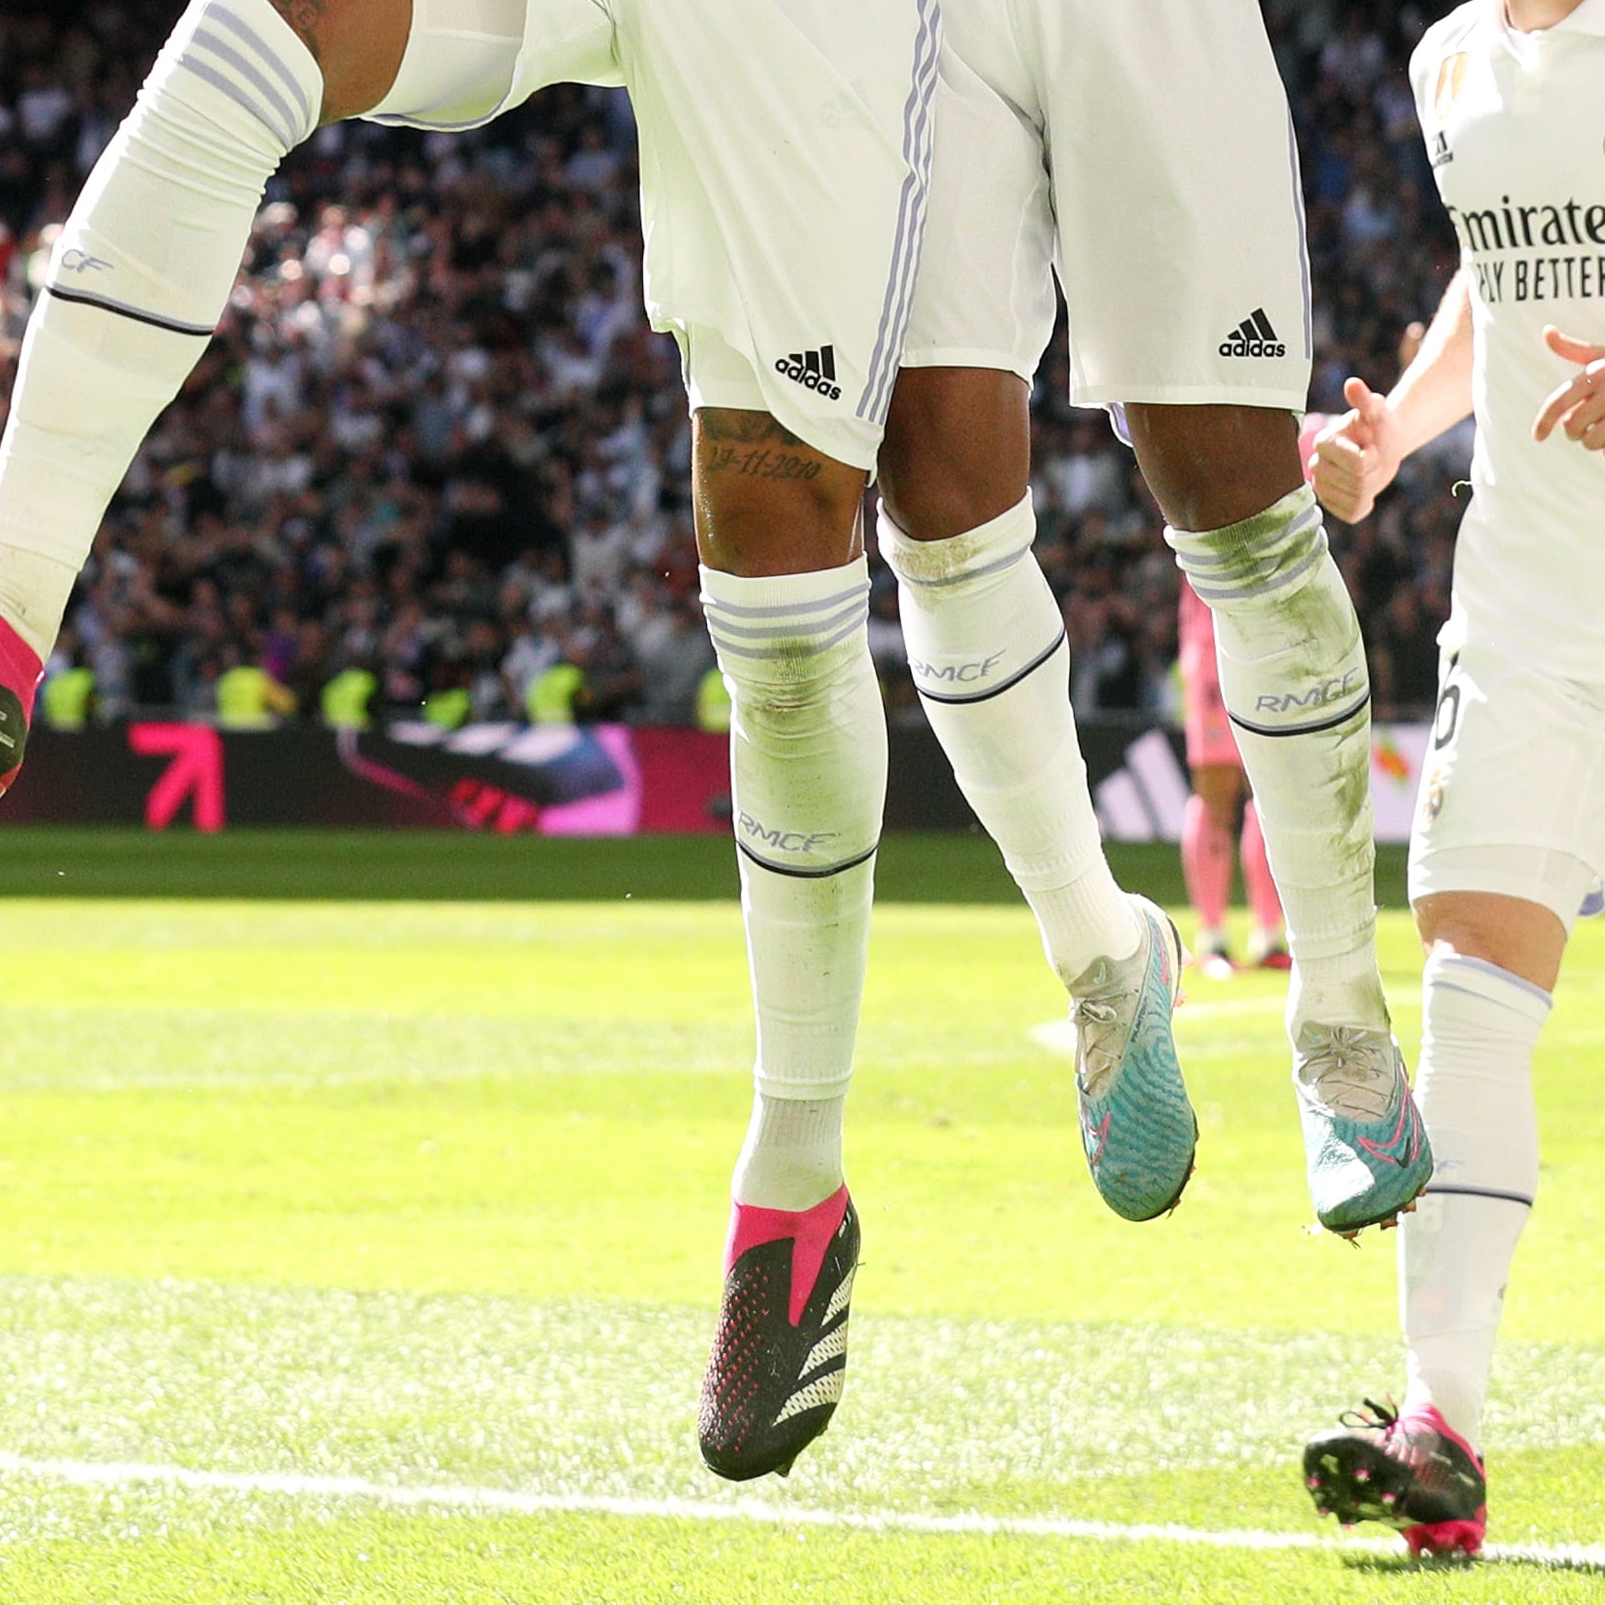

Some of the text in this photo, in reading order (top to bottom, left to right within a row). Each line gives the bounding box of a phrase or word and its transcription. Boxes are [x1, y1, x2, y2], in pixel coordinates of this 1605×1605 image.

[61, 249, 115, 273] CF
[1218, 340, 1286, 358] adidas
[775, 358, 842, 401] adidas
[1256, 667, 1359, 712] RMCF
[738, 810, 837, 852] RMCF
